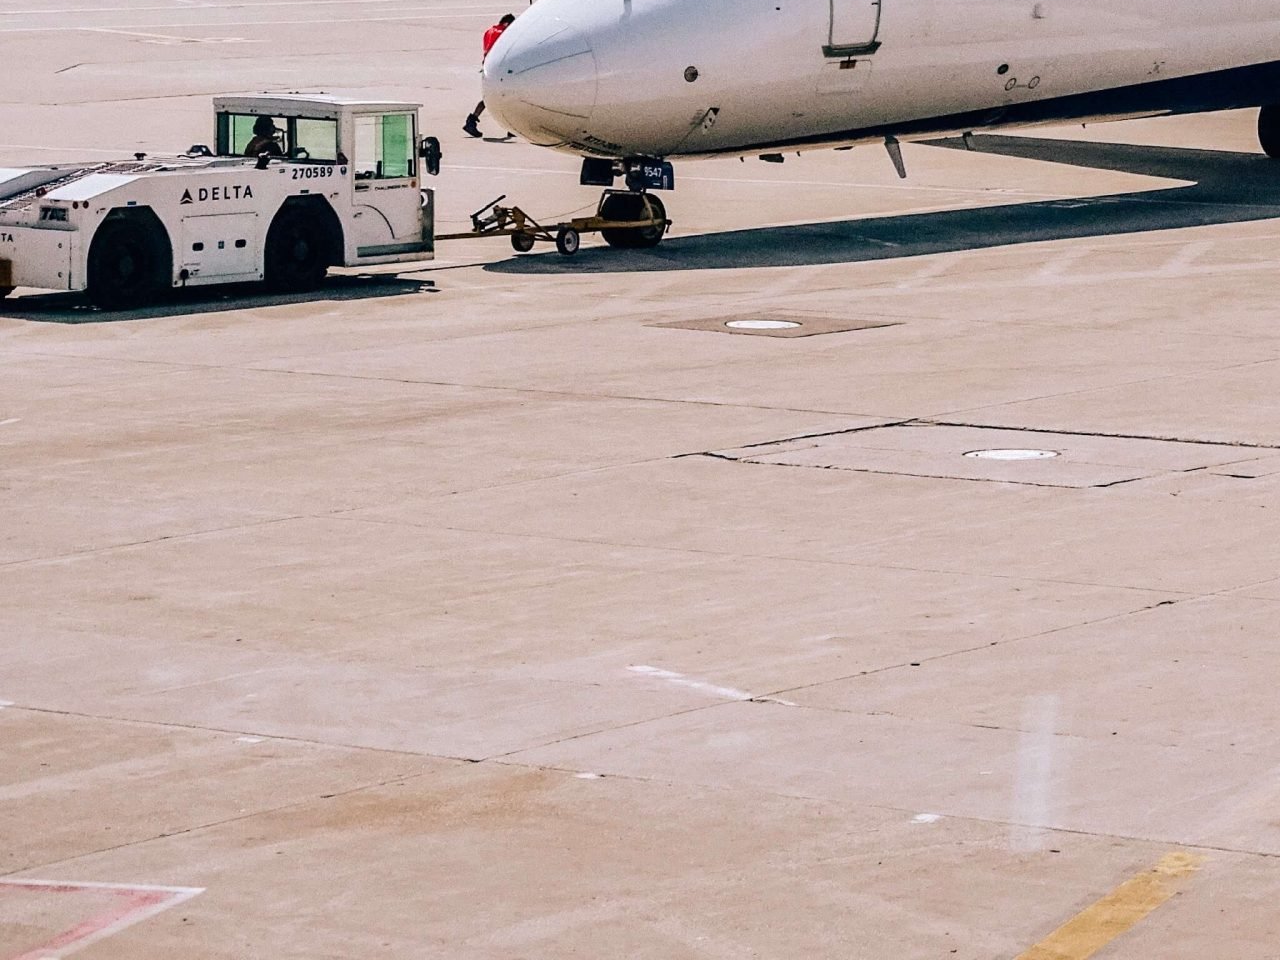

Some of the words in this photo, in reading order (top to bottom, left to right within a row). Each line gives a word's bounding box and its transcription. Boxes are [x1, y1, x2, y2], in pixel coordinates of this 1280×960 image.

[291, 166, 333, 180] 270589
[644, 166, 662, 177] 9547
[198, 185, 253, 201] DELTA
